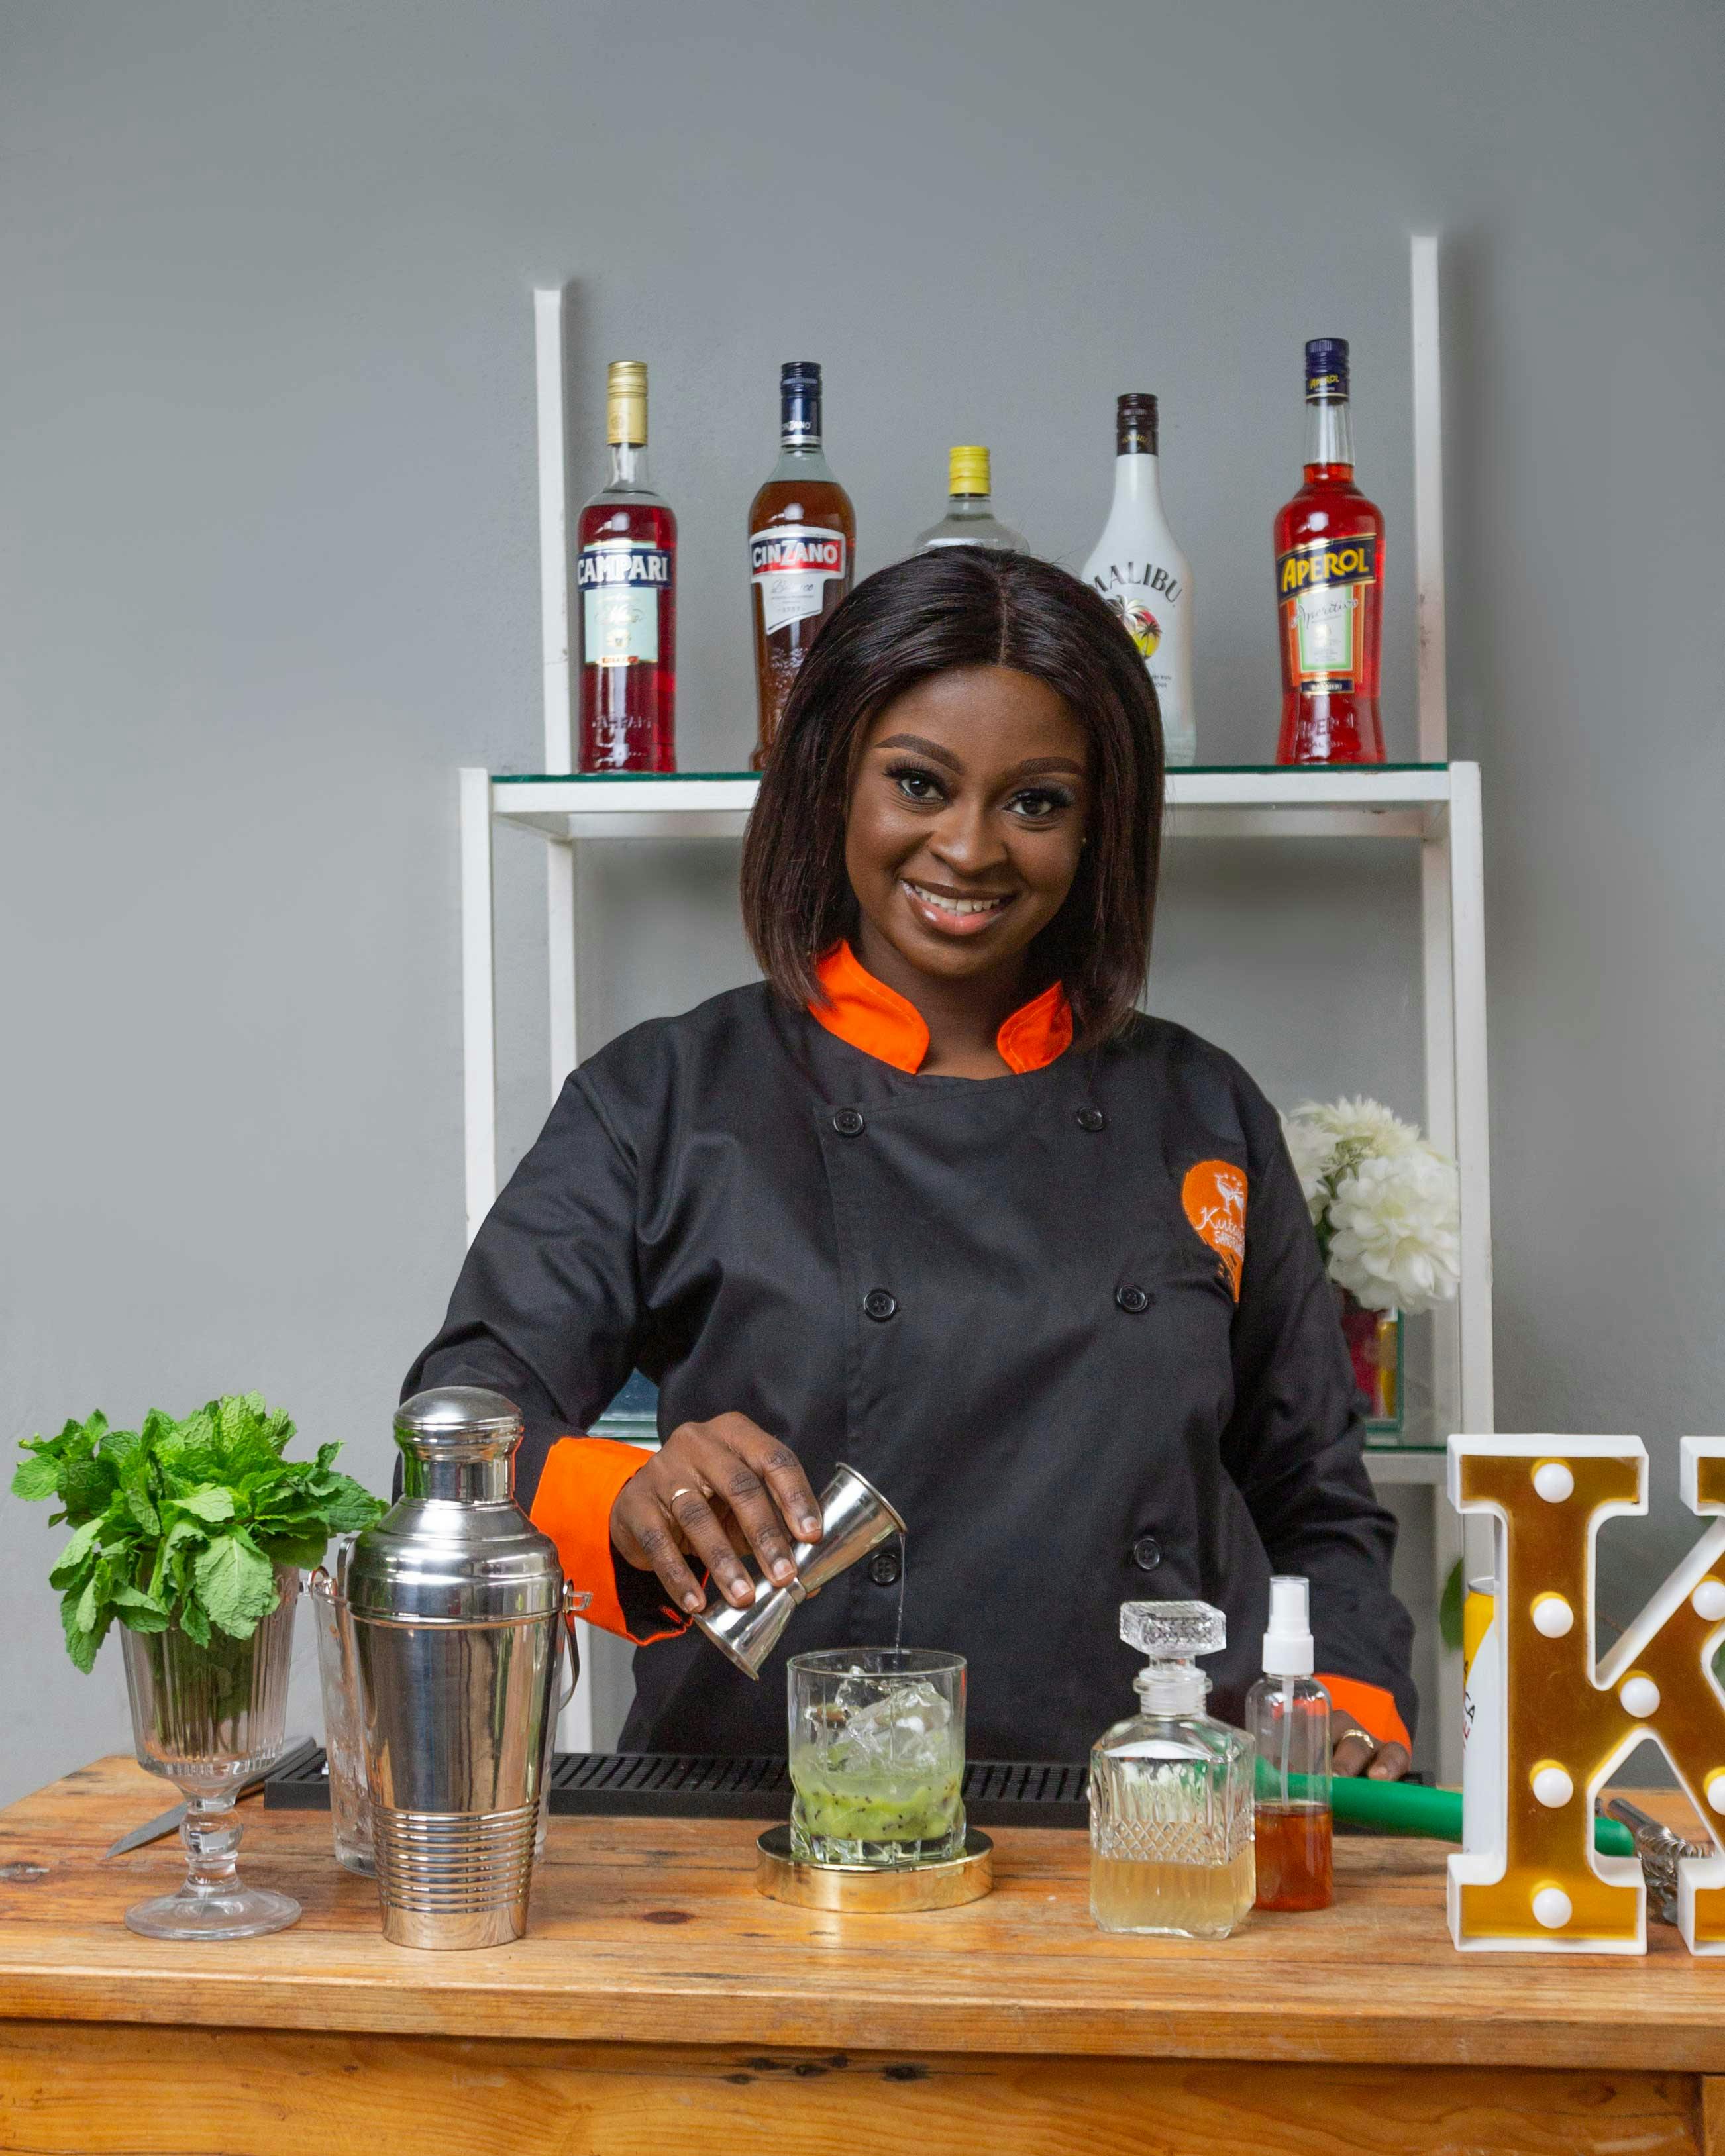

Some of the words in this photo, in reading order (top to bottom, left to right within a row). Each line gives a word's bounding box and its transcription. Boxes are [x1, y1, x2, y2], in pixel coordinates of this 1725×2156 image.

[578, 554, 668, 585] CAMPARI
[753, 540, 838, 568] CINZANO
[1281, 548, 1369, 593] APEROL
